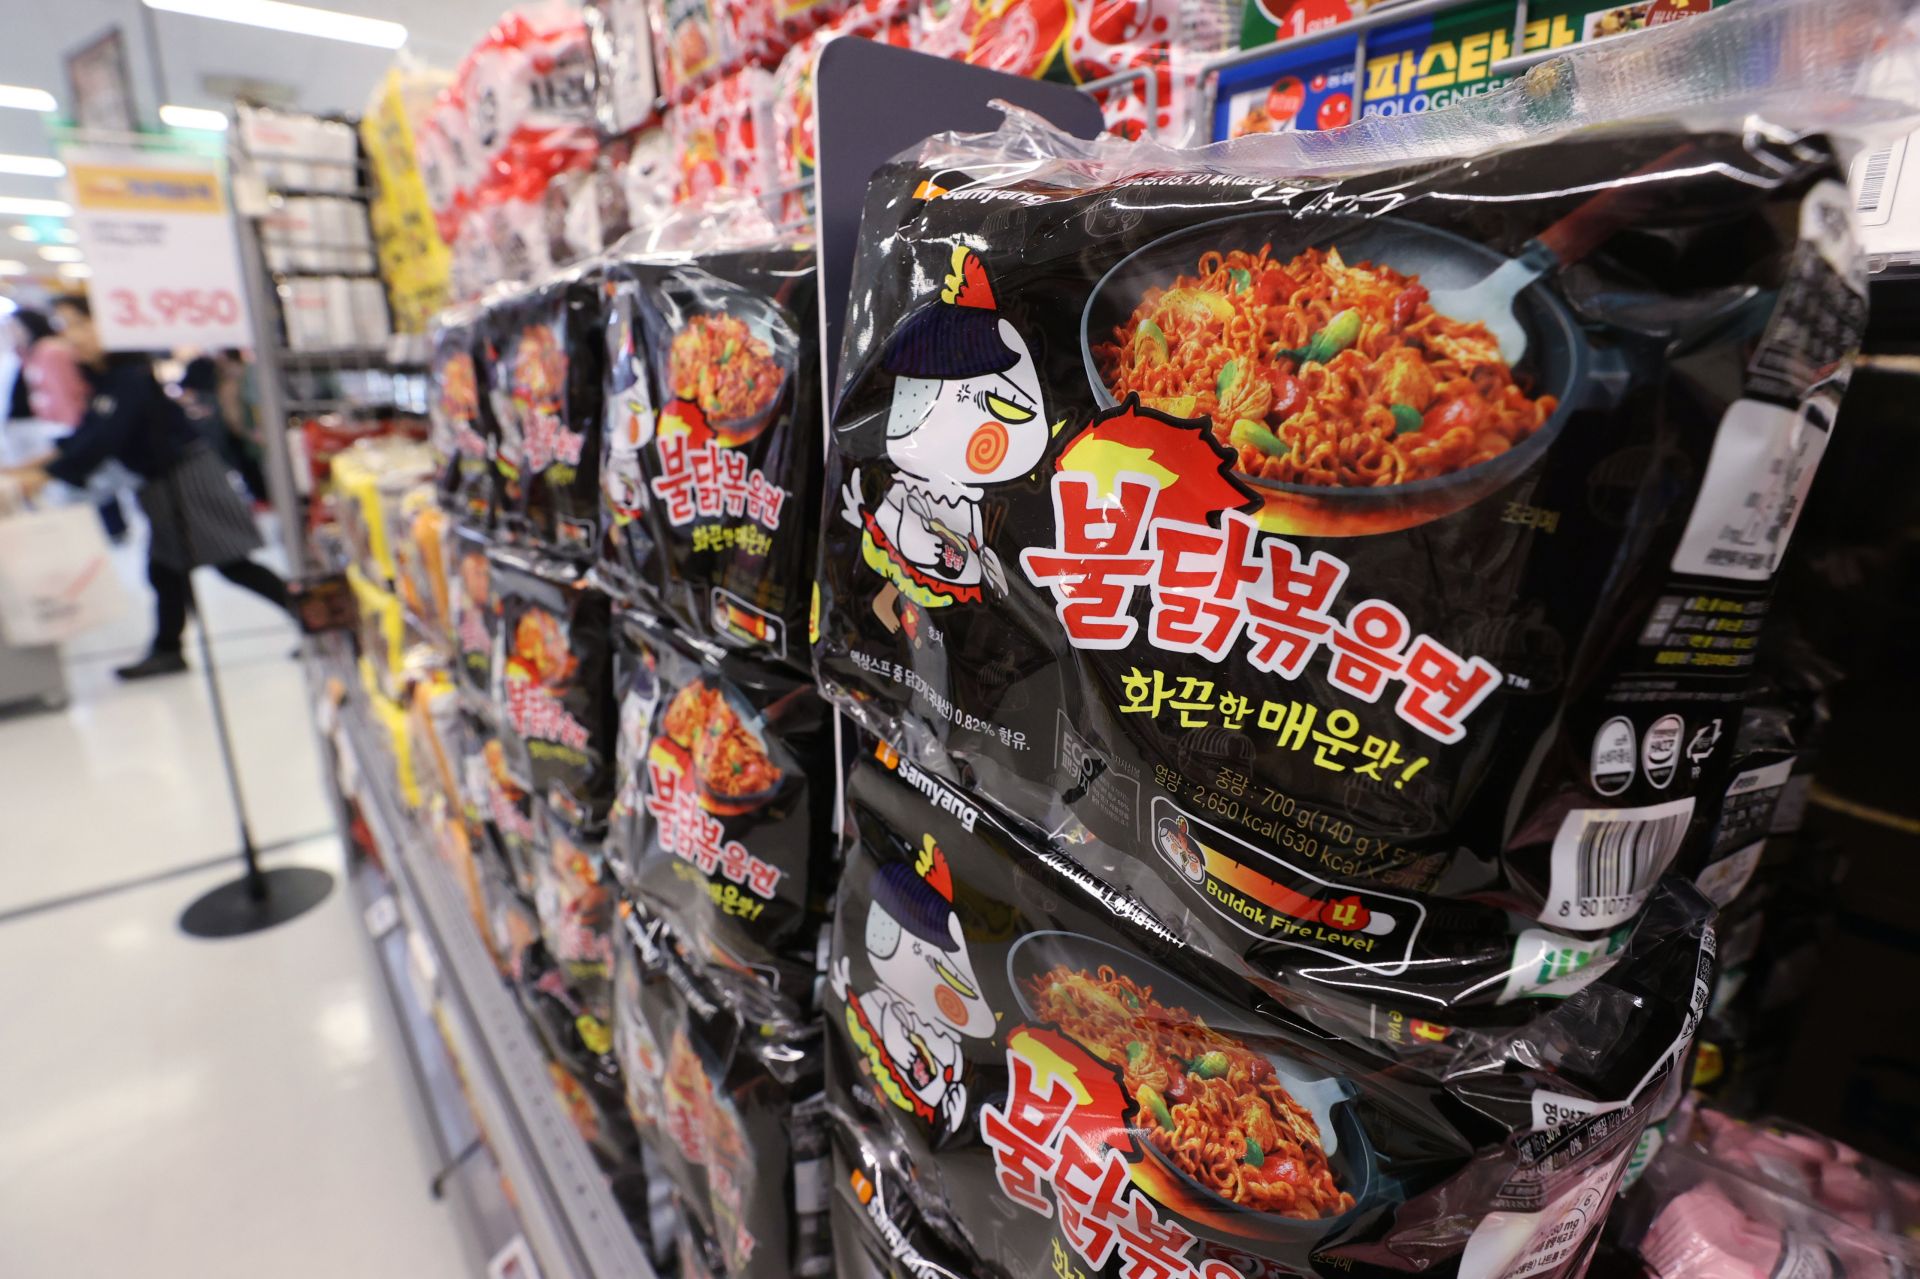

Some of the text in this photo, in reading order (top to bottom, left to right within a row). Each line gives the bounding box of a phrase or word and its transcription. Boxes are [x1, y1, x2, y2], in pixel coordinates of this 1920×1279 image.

[651, 433, 785, 530] 불닭볶음면
[1019, 471, 1503, 745] 불닭볶음면
[892, 664, 904, 683] 중
[954, 709, 996, 737] 0.82%
[999, 726, 1031, 751] 함유.
[1118, 666, 1431, 790] 화끈한 매운맛!
[1063, 731, 1094, 777] ECO
[1215, 766, 1249, 797] 중량
[1261, 787, 1296, 817] 700
[897, 758, 979, 834] samyang
[1154, 764, 1182, 793] 열량
[1192, 785, 1240, 820] 2,650
[1205, 878, 1268, 926] Buldak
[1270, 914, 1313, 938] Fire
[1314, 926, 1376, 953] Level
[1332, 904, 1356, 927] 4
[1558, 900, 1571, 917] 8
